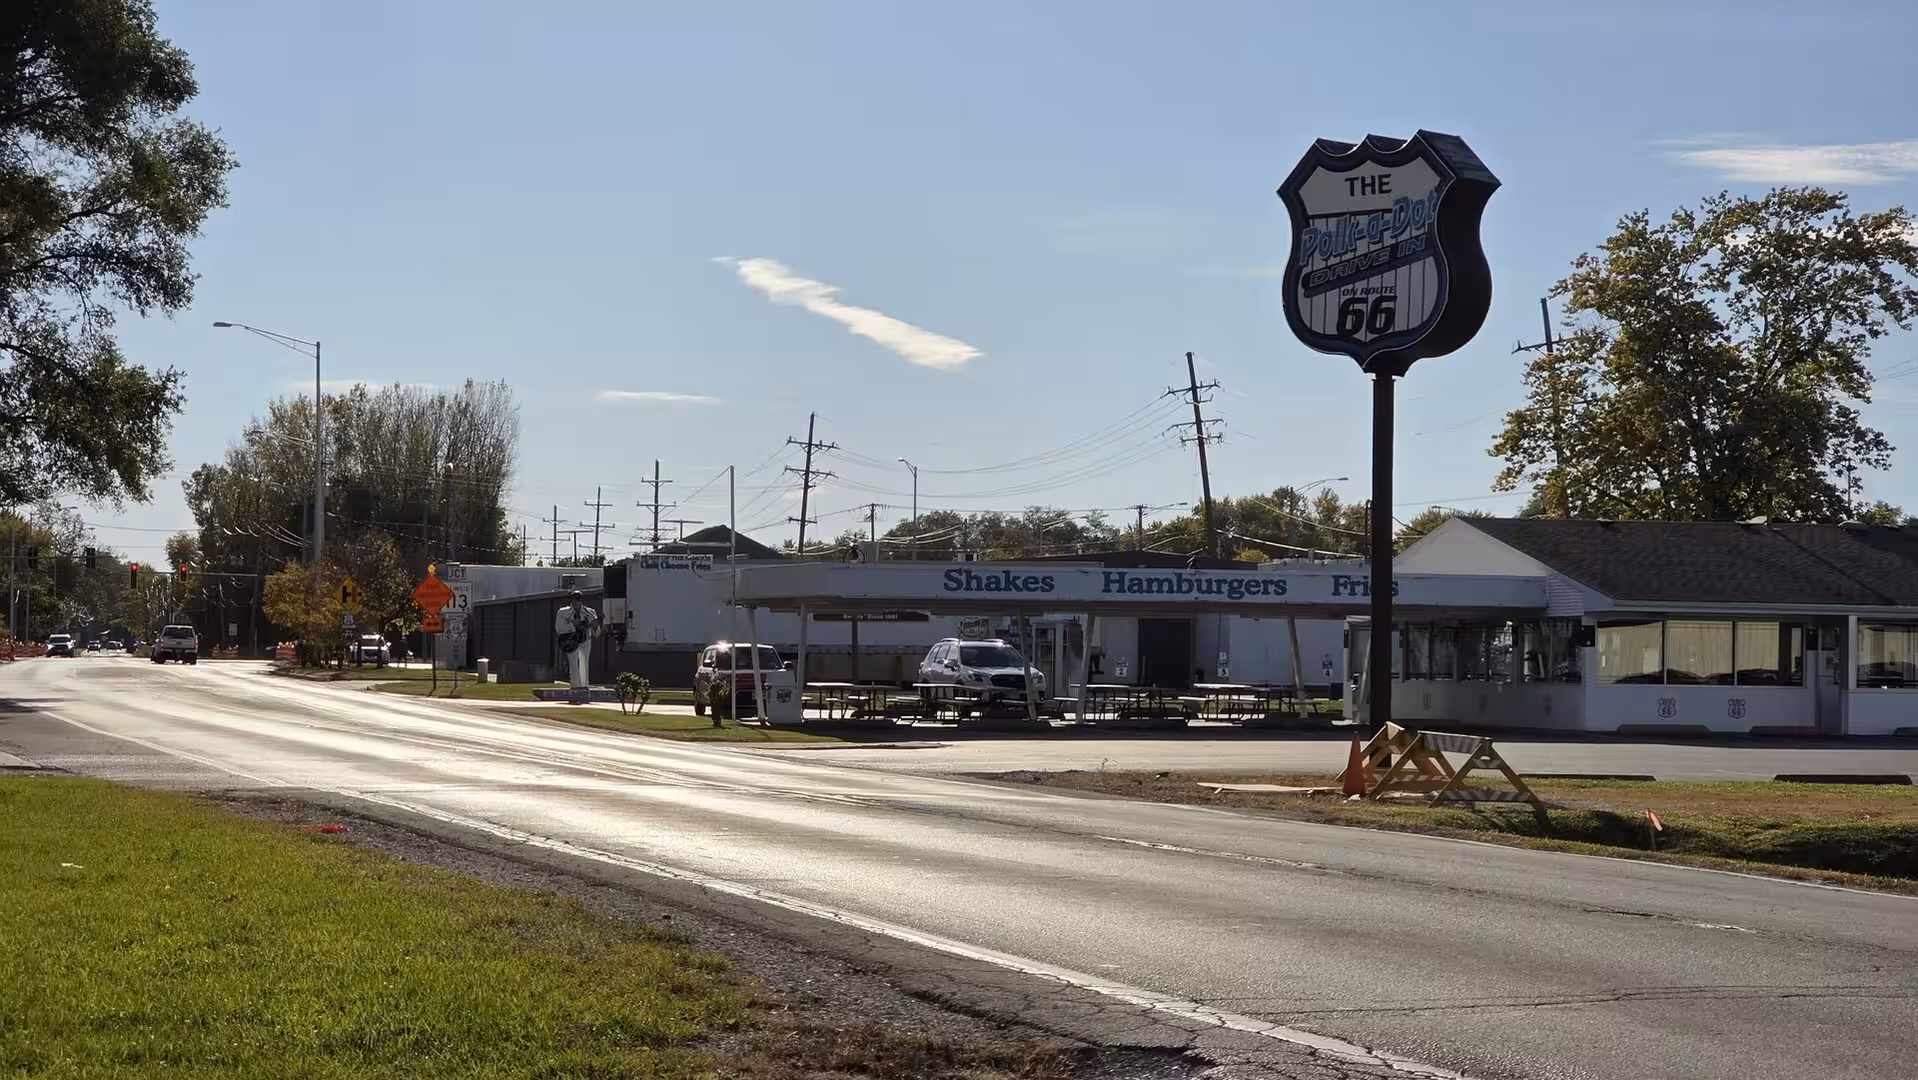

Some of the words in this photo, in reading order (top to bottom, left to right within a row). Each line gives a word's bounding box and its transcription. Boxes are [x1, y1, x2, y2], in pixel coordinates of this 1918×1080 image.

[1345, 174, 1392, 197] THE
[1300, 190, 1439, 267] Polk-a-Dot
[1309, 247, 1391, 288] DRIVE
[1397, 234, 1426, 258] IN
[1342, 287, 1357, 296] ON
[1360, 285, 1395, 295] ROUTE
[1336, 296, 1398, 337] 66
[943, 568, 1055, 592] Shakes
[1101, 571, 1288, 600] Hamburgers
[1331, 575, 1399, 596] Fris
